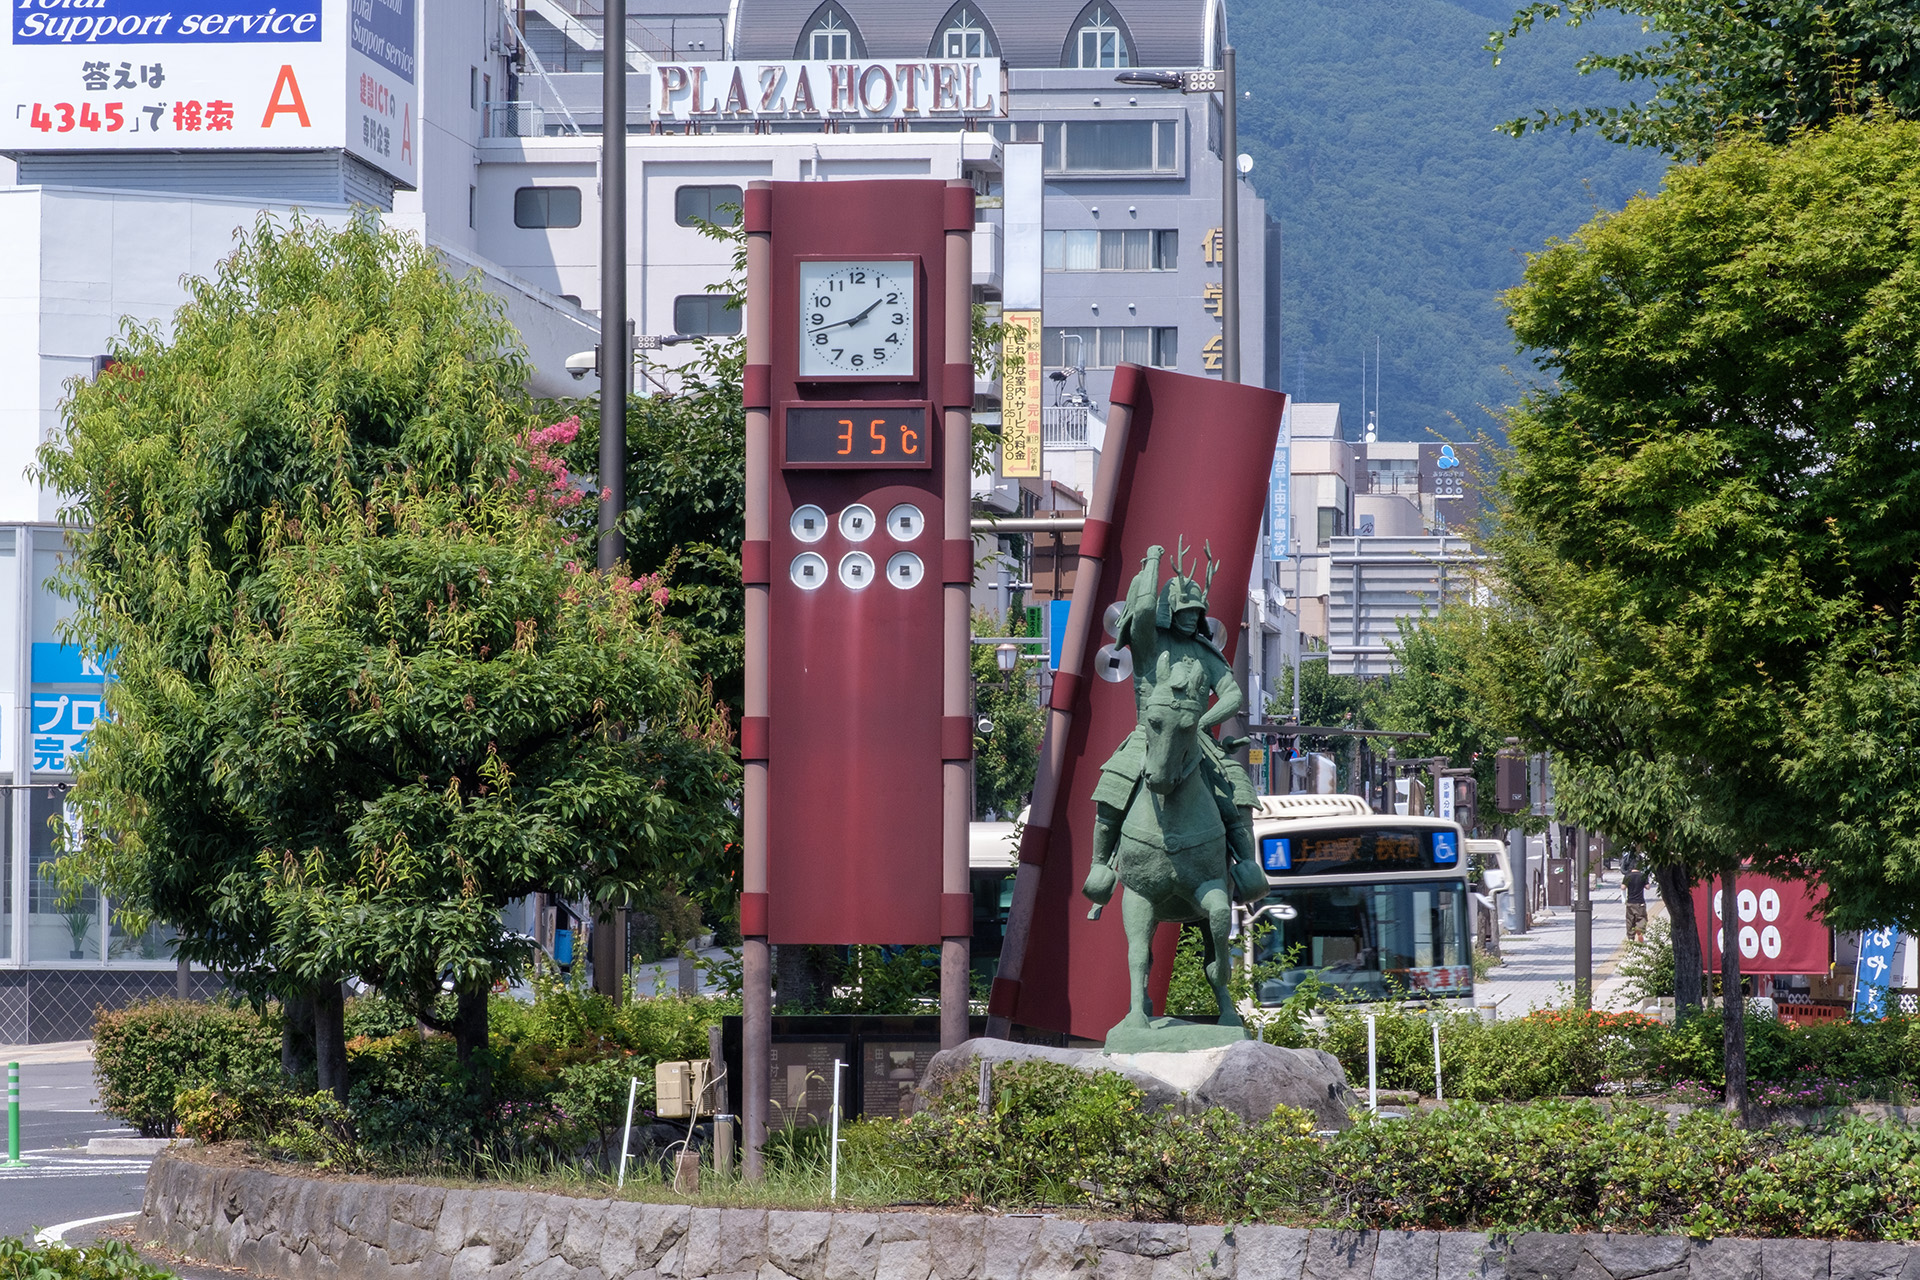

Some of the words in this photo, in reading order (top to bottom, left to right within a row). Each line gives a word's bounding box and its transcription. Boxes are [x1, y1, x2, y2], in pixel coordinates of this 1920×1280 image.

[18, 13, 173, 42] Support
[178, 8, 317, 35] service
[352, 18, 385, 54] Support
[386, 47, 414, 75] service
[82, 61, 166, 92] 答えは
[657, 65, 820, 116] PLAZA
[828, 63, 993, 113] HOTEL
[260, 64, 312, 128] A
[15, 99, 235, 133] 「4345」で検索
[401, 103, 412, 166] A
[849, 272, 865, 284] 12
[876, 277, 881, 288] 1
[829, 280, 843, 291] 11
[814, 296, 831, 308] 10
[886, 293, 898, 304] 2
[811, 313, 824, 325] 9
[891, 313, 904, 324] 3
[815, 333, 829, 345] 8
[885, 333, 899, 344] 4
[831, 349, 844, 360] 7
[851, 354, 864, 366] 6
[873, 348, 886, 360] 5
[1015, 332, 1026, 460] きれな室内・サービス料金
[1028, 352, 1040, 433] 駐車場完備
[1273, 481, 1286, 556] 上田予備学校
